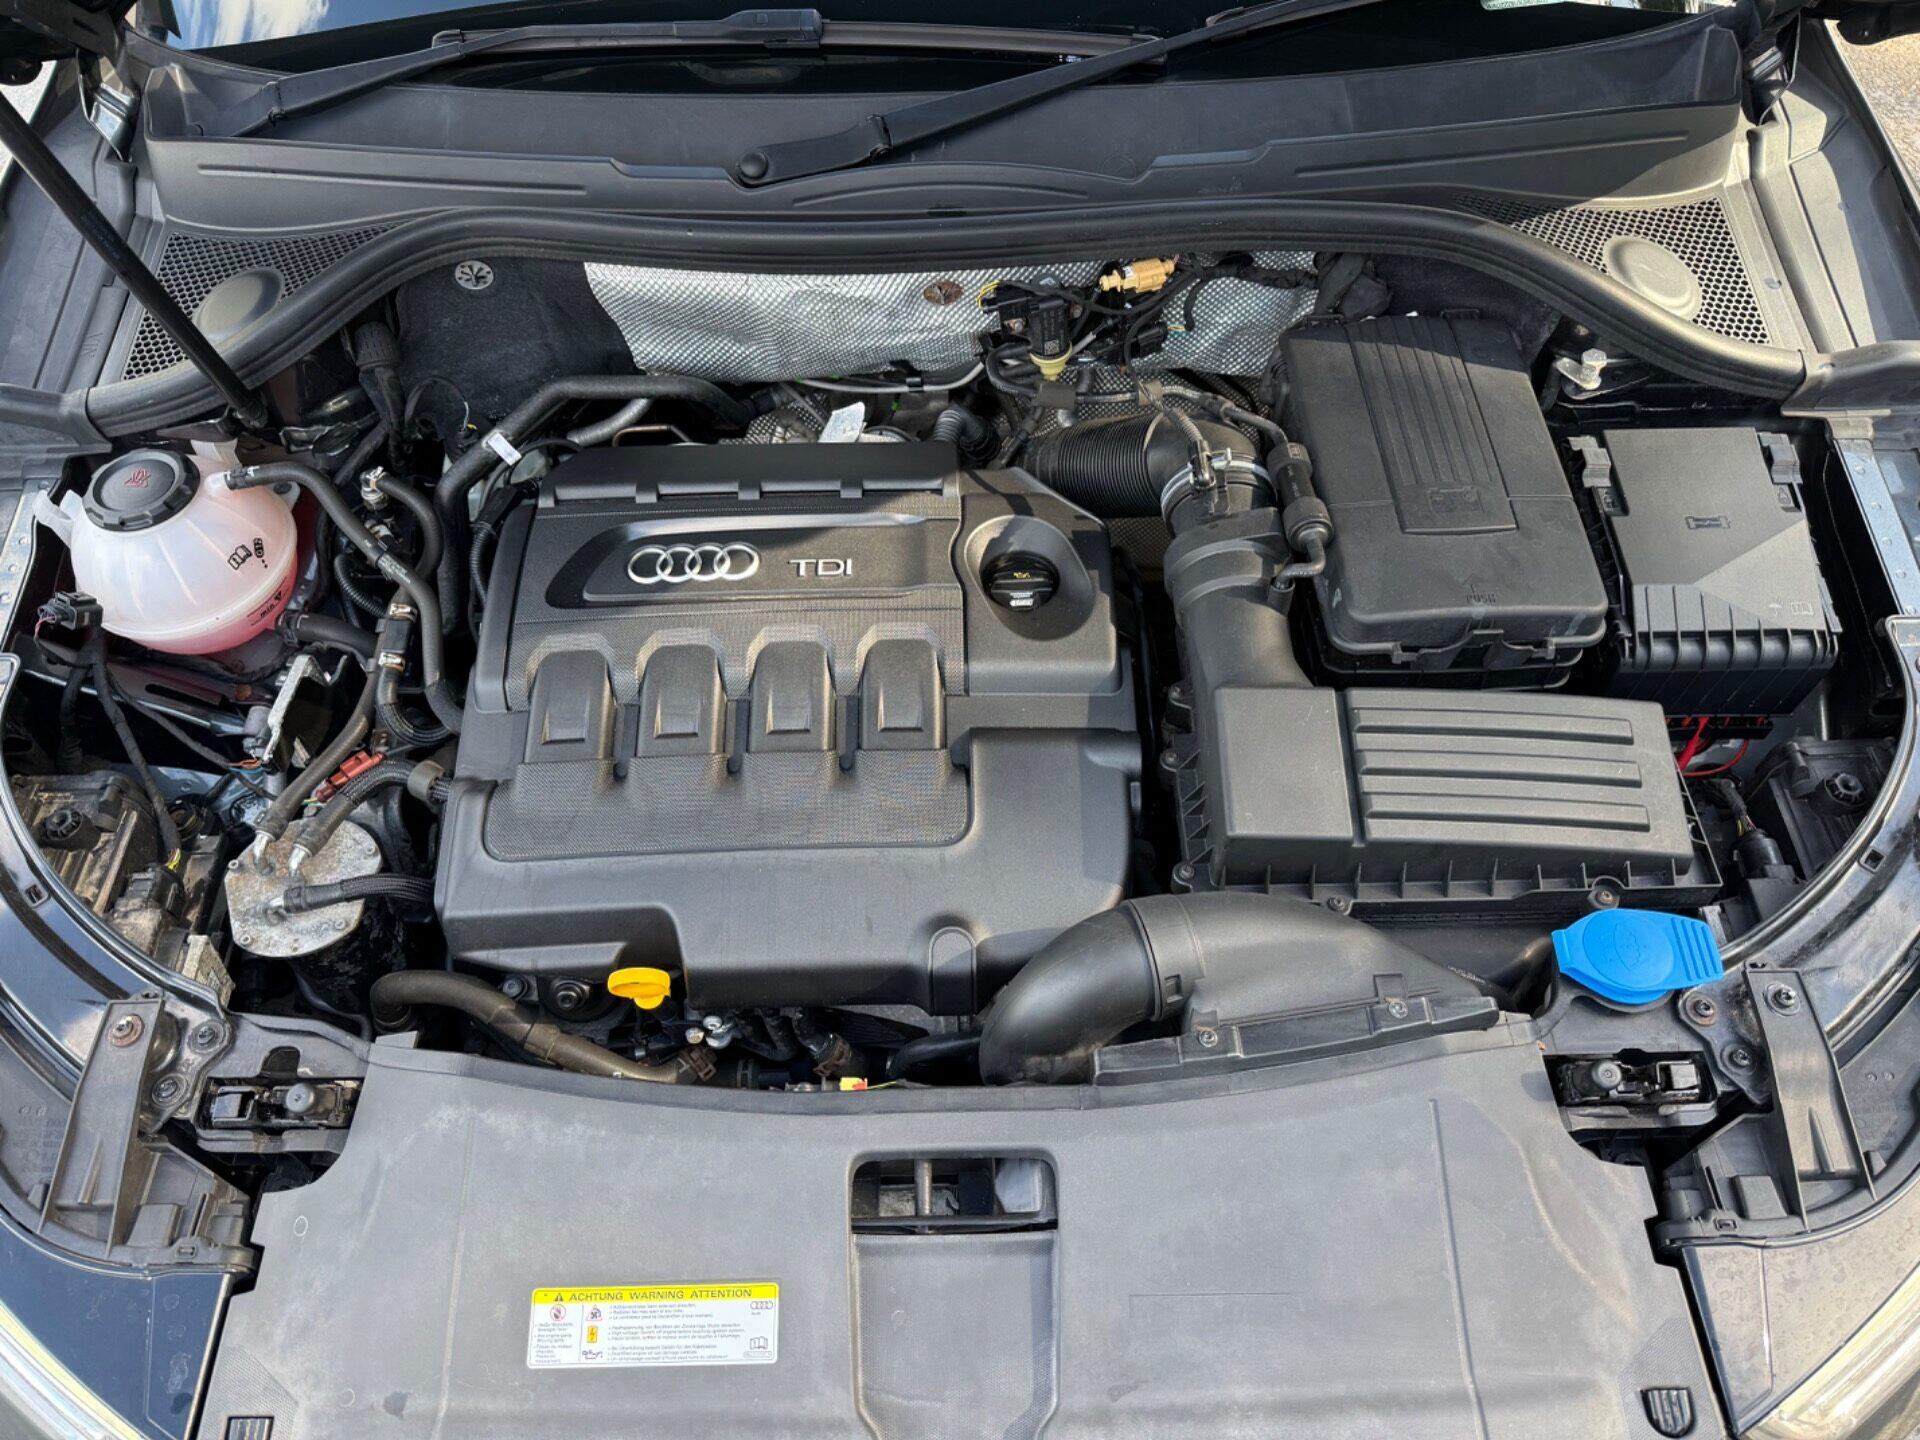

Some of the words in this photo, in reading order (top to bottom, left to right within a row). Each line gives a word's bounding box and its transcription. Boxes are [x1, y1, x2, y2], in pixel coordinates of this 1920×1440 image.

[789, 558, 852, 577] TDI
[569, 1292, 624, 1302] ACHTUNG
[630, 1290, 684, 1300] WARNING
[690, 1288, 752, 1299] ATTENTION
